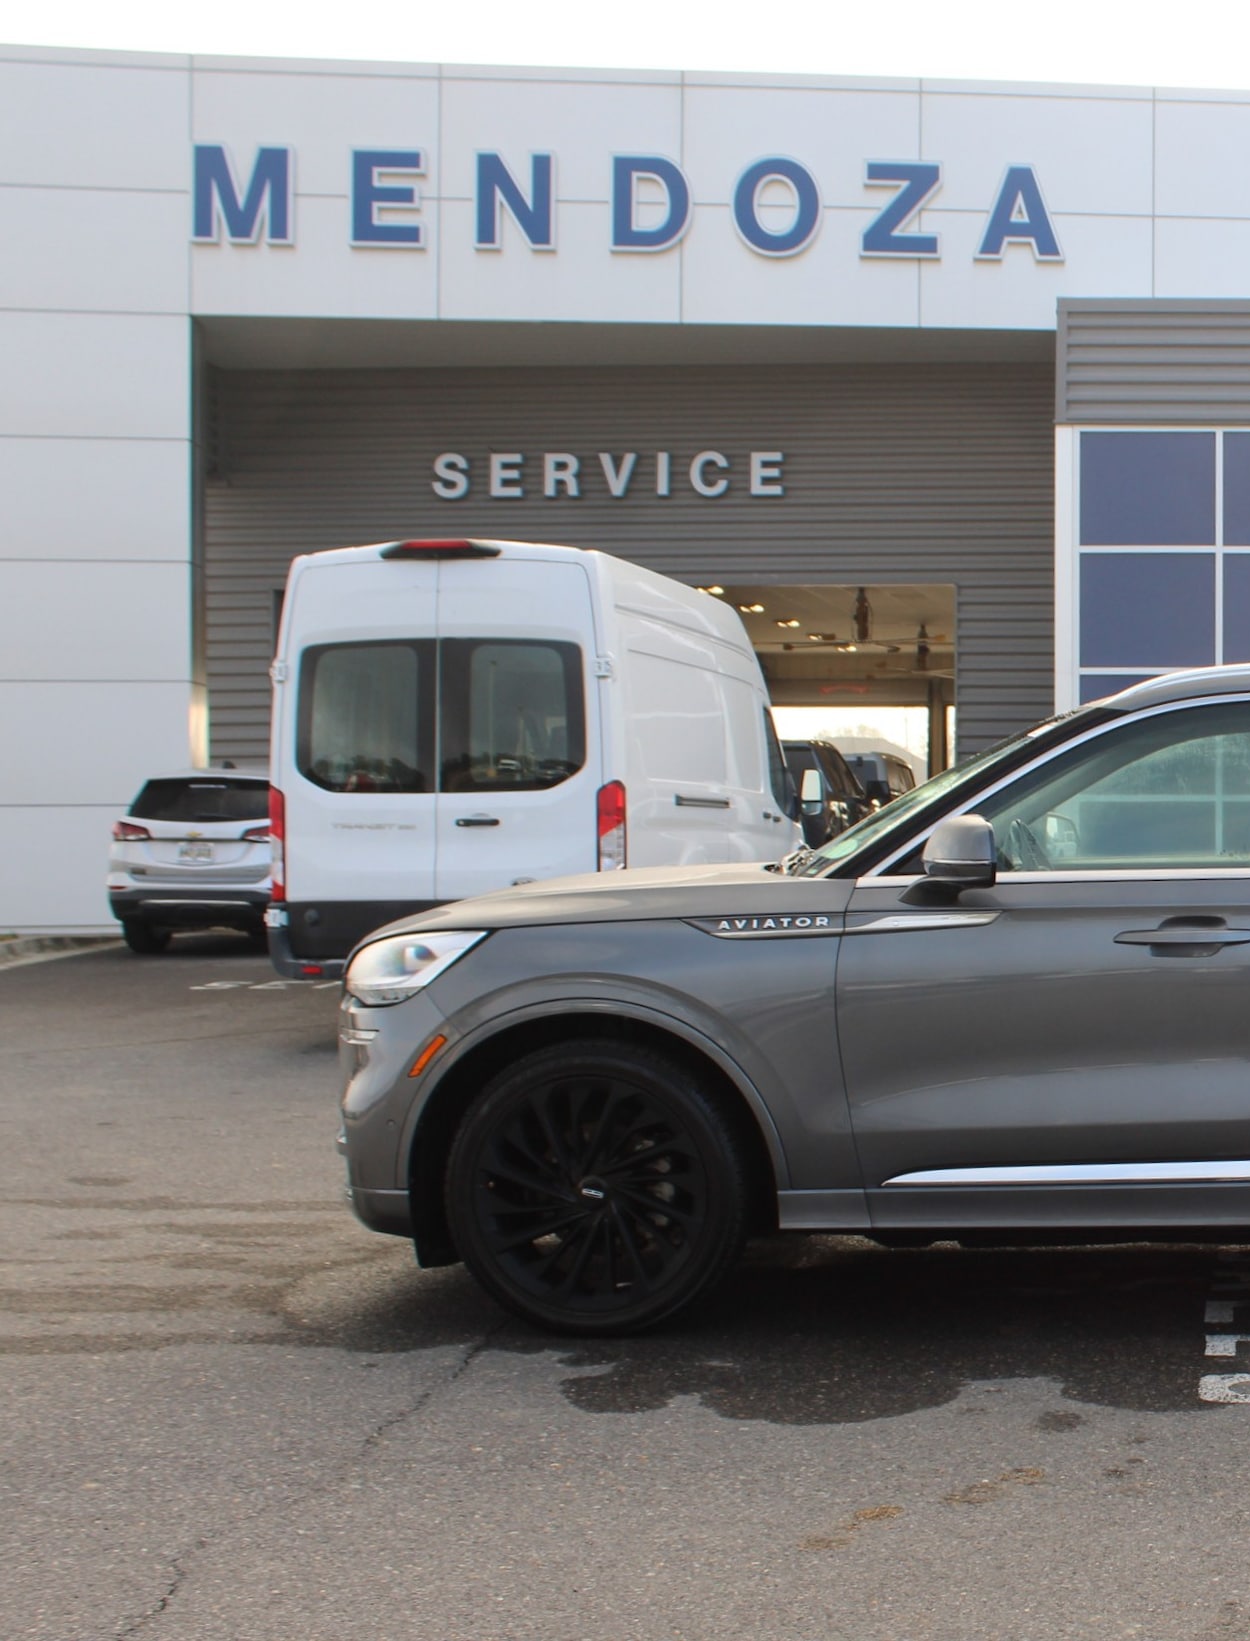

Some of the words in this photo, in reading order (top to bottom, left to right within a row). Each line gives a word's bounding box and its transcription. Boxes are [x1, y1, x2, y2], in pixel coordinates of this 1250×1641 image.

[190, 143, 1064, 261] MENDOZA
[431, 450, 785, 498] SERVICE
[718, 916, 830, 930] AVIATOR
